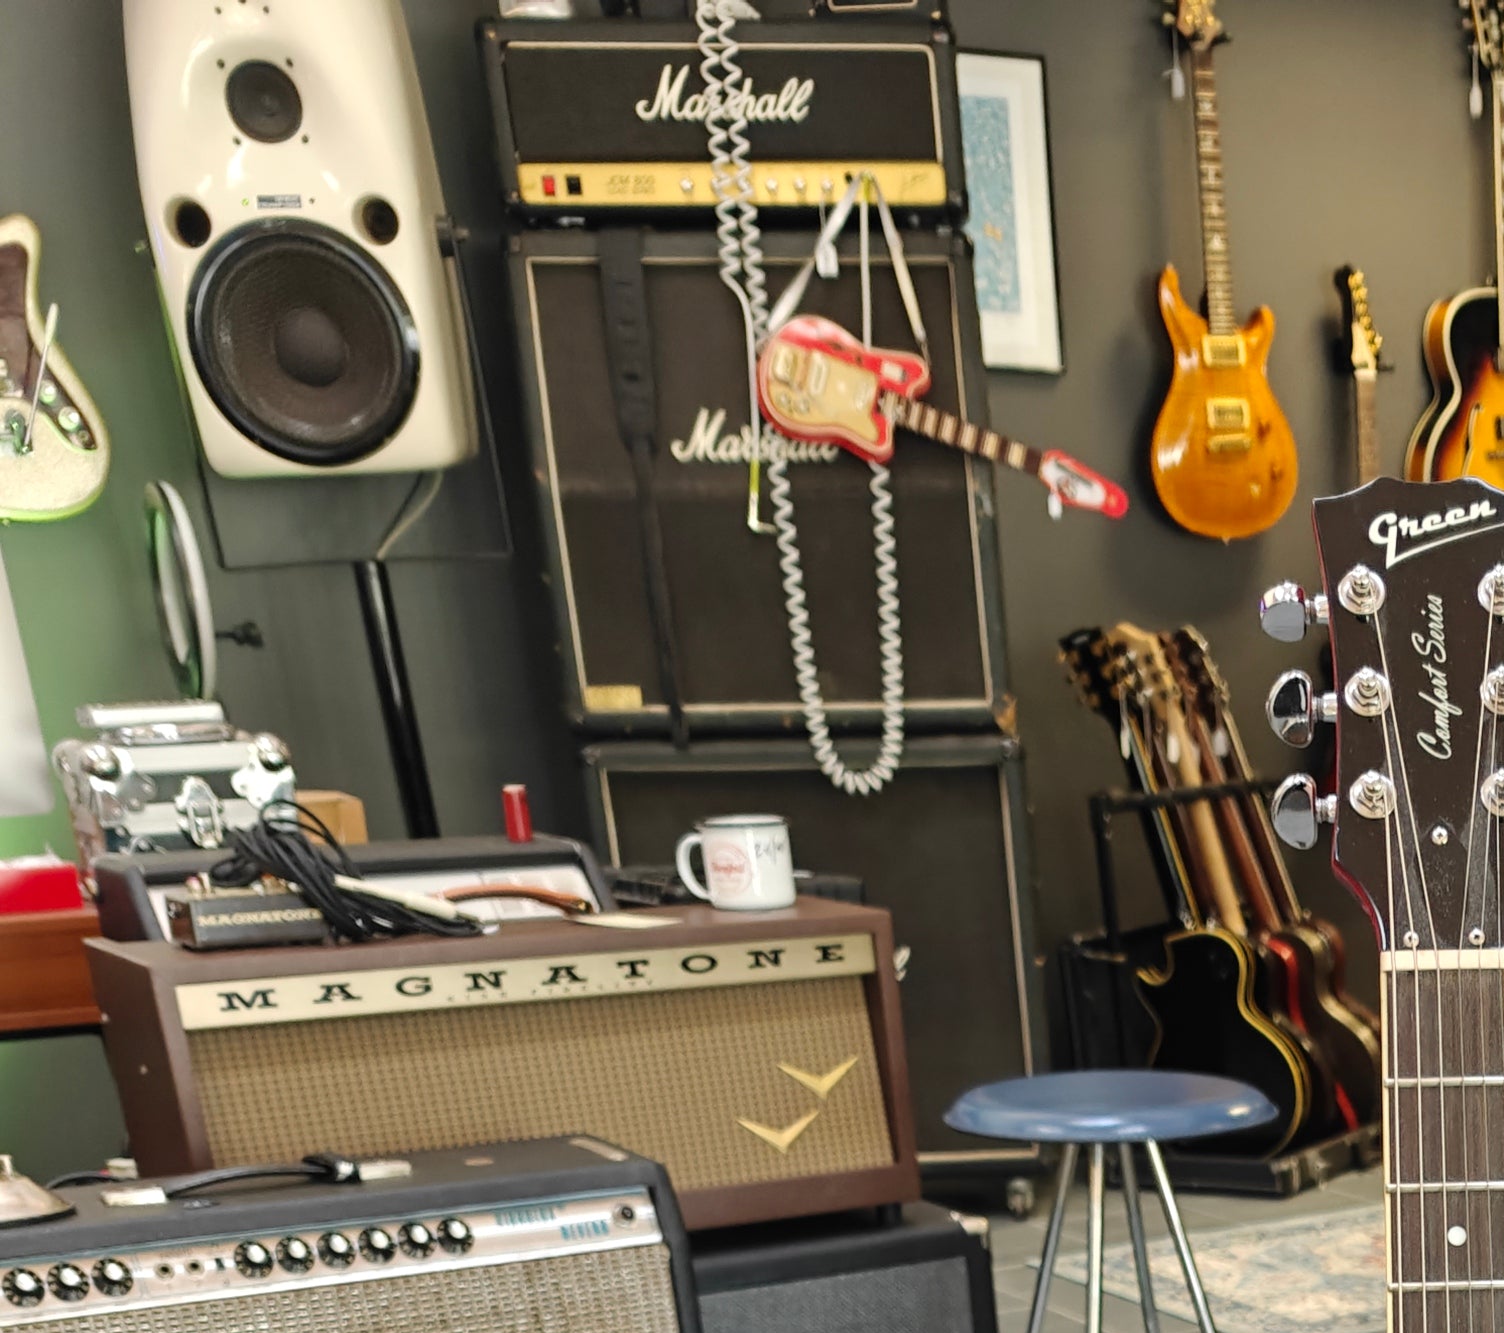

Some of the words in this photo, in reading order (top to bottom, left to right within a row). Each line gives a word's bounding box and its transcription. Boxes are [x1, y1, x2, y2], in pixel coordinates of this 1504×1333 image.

[1411, 593, 1447, 663] Series
[1416, 662, 1463, 760] Comfort
[216, 943, 845, 1013] MAGNATONE
